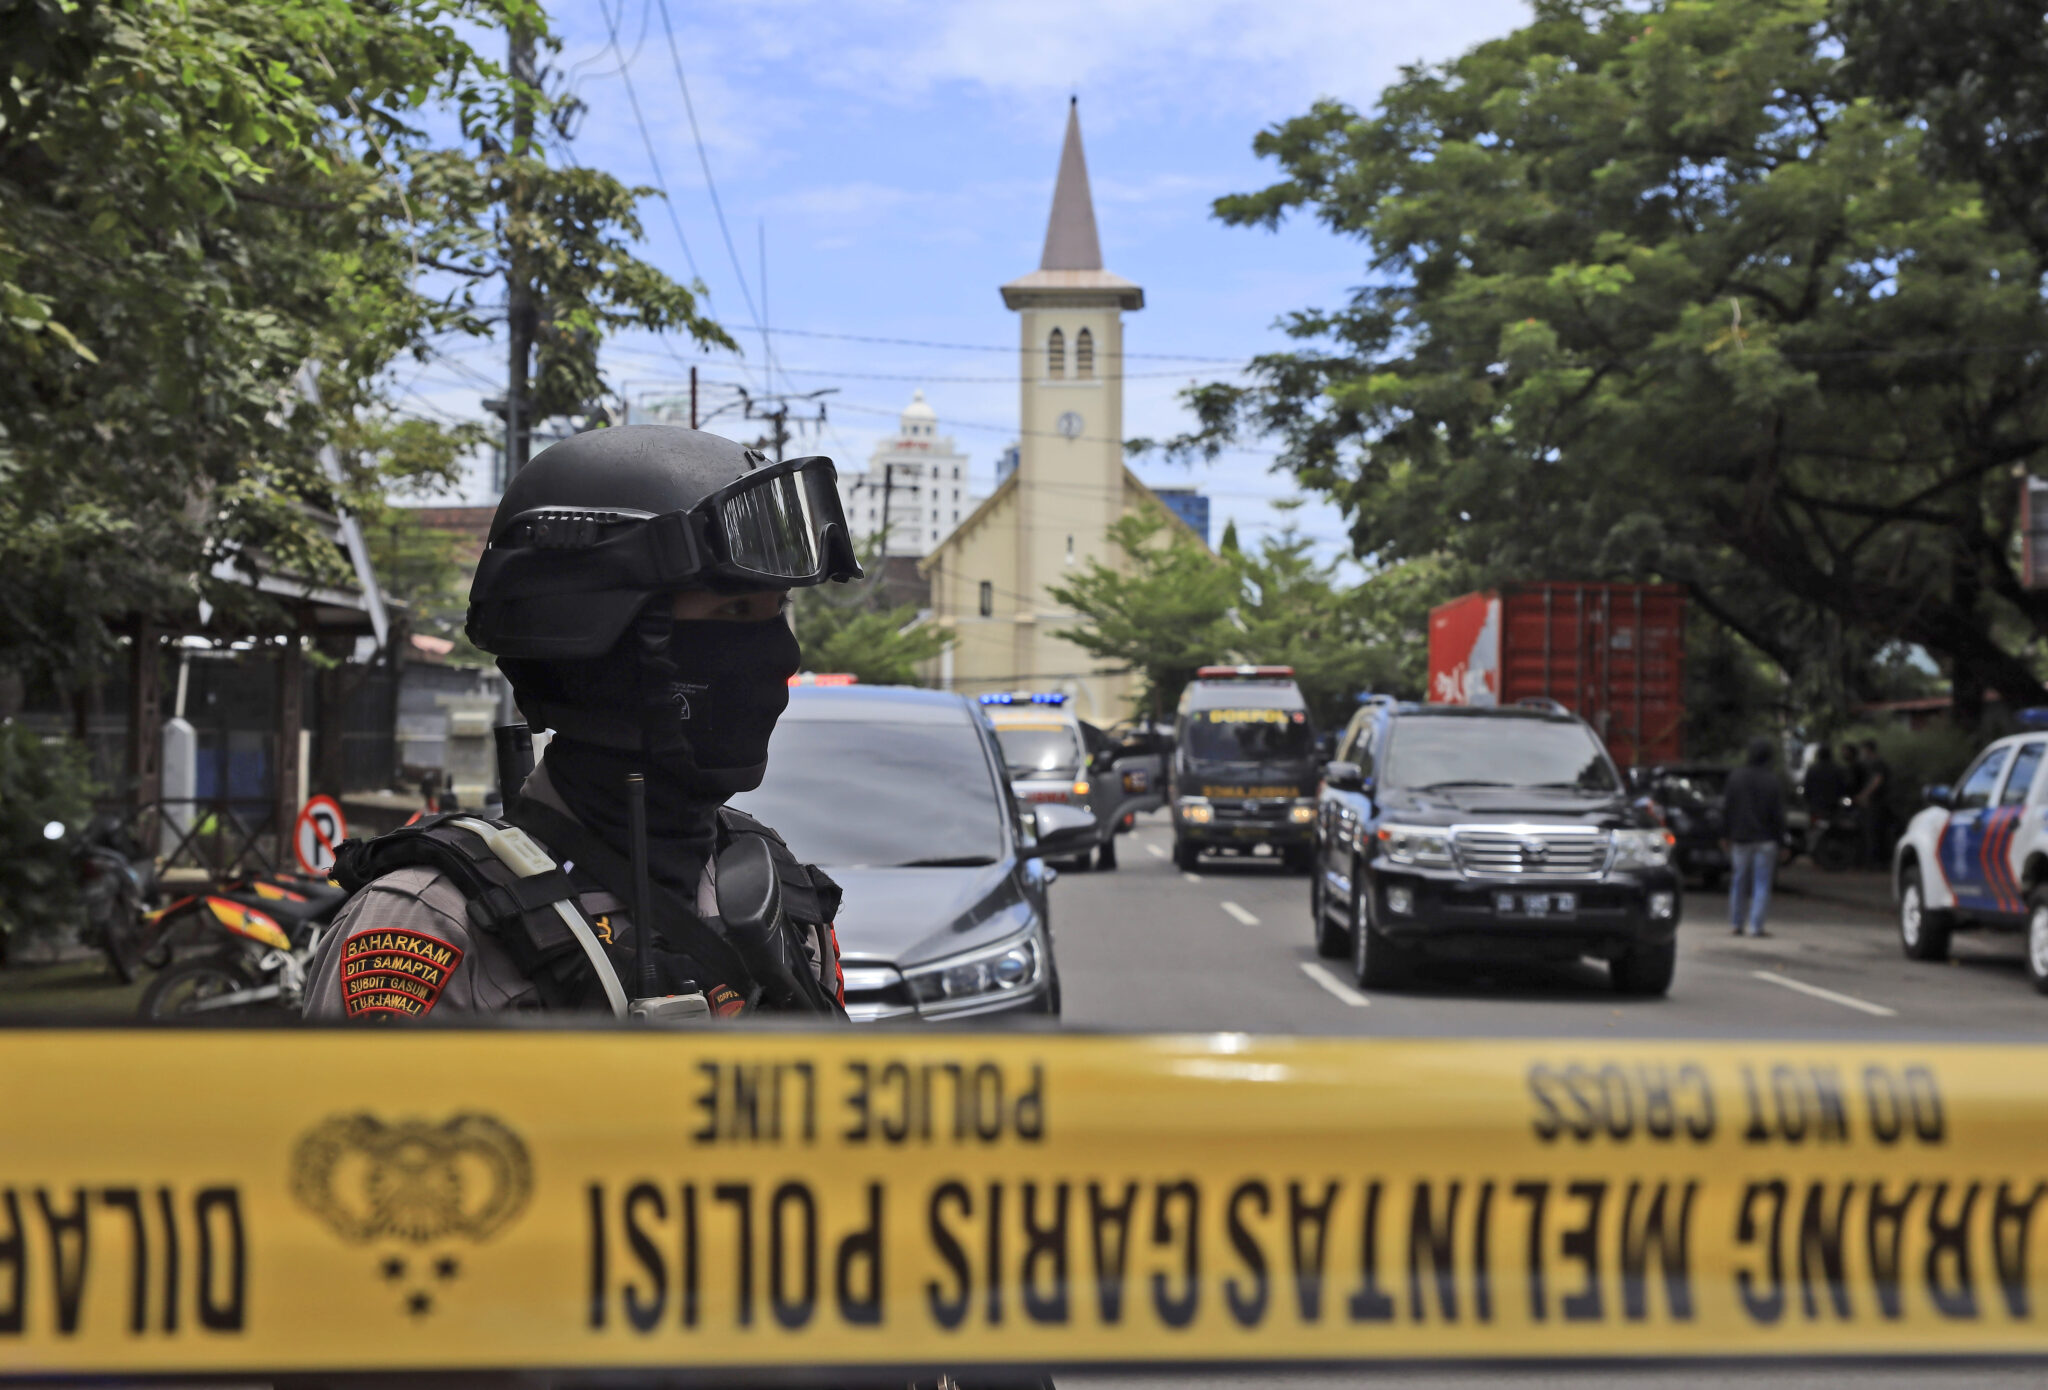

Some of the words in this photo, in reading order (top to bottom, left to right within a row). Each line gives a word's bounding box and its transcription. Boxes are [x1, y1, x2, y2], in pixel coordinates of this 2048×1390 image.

[347, 959, 367, 976] DIT
[373, 956, 439, 984] SAMAPTA
[348, 933, 452, 966] BAHARKAM
[350, 976, 386, 993] SUBDIT
[390, 978, 430, 1000] GASUM
[350, 994, 422, 1016] TURJAWALI
[693, 1060, 818, 1144] LINE
[842, 1060, 1046, 1144] POLICE
[1526, 1061, 1716, 1144] CROSS
[1739, 1064, 1851, 1145] NOT
[1861, 1064, 1946, 1144] DO
[588, 1179, 885, 1333] POLISI
[1734, 1179, 2048, 1327] ARANG
